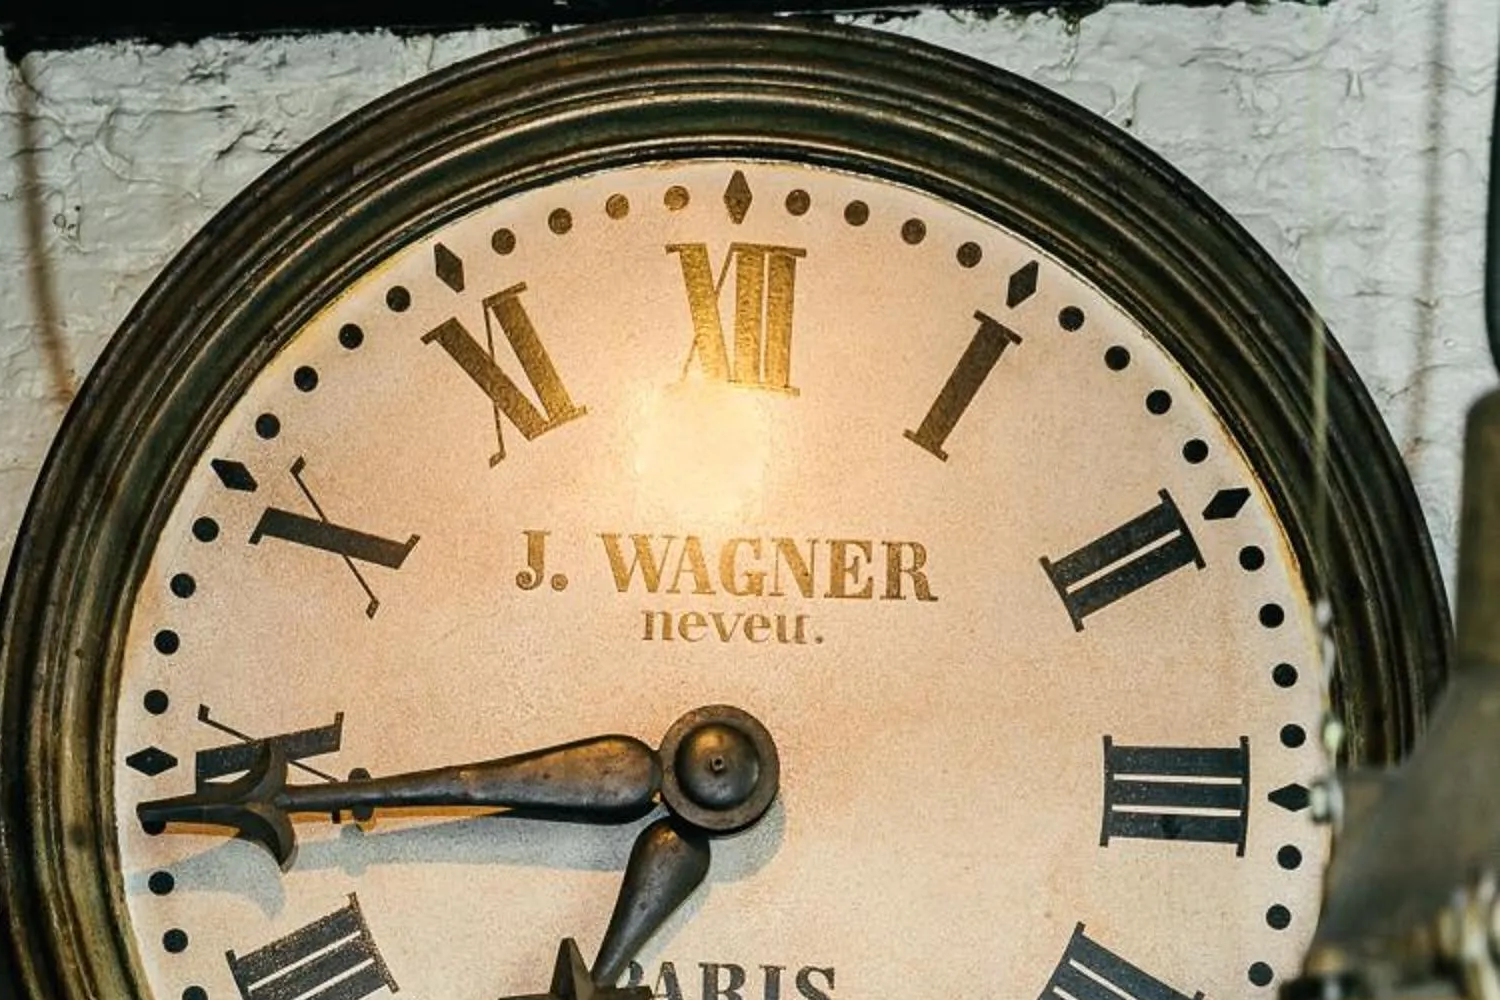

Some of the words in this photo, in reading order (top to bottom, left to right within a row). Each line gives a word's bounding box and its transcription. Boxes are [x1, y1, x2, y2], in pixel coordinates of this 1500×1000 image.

[666, 243, 807, 396] XII
[515, 530, 569, 592] J.
[597, 533, 939, 602] WAGNER
[641, 608, 824, 645] neveu.
[1101, 734, 1250, 856] III
